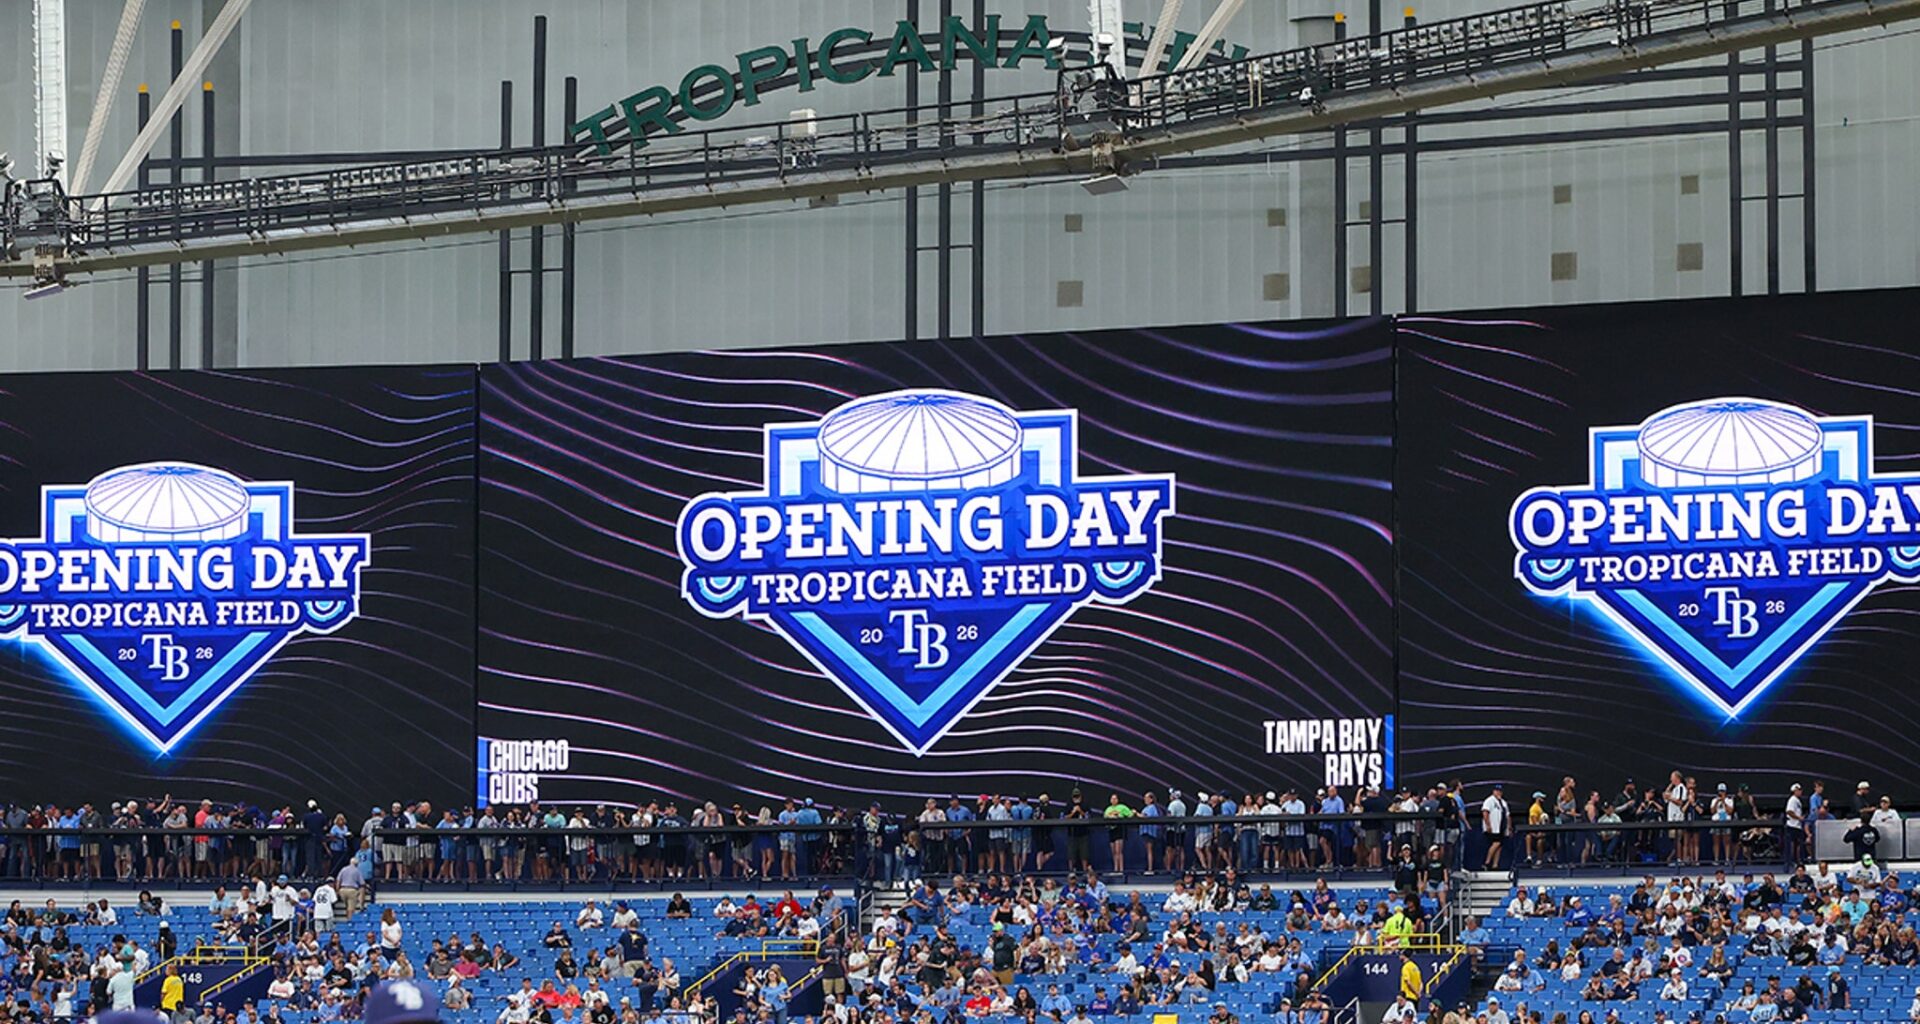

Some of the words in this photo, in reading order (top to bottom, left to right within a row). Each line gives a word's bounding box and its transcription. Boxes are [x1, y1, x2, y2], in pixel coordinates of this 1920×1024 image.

[569, 14, 1061, 157] TROPICANA
[691, 496, 1003, 562] OPENING
[1025, 489, 1161, 549] DAY
[1522, 489, 1807, 546] OPENING
[251, 545, 359, 589] DAY
[752, 567, 973, 604] TROPICANA
[982, 563, 1087, 597] FIELD
[1579, 550, 1780, 583] TROPICANA
[1788, 547, 1883, 576] FIELD
[31, 601, 209, 628] TROPICANA
[216, 600, 300, 626] FIELD
[1678, 603, 1699, 616] 20
[1704, 586, 1759, 638] TB
[1765, 600, 1786, 614] 26
[118, 648, 137, 661] 20
[141, 633, 190, 681] TB
[195, 647, 214, 659] 26
[860, 629, 883, 643] 20
[888, 609, 949, 669] TB
[956, 625, 978, 641] 26
[1263, 719, 1336, 753] TAMPA
[1339, 718, 1382, 752] BAY
[489, 740, 569, 772] CHICAGO
[1325, 753, 1382, 786] RAYS
[489, 773, 539, 804] CUBS
[181, 972, 203, 984] 148
[1364, 963, 1389, 975] 144
